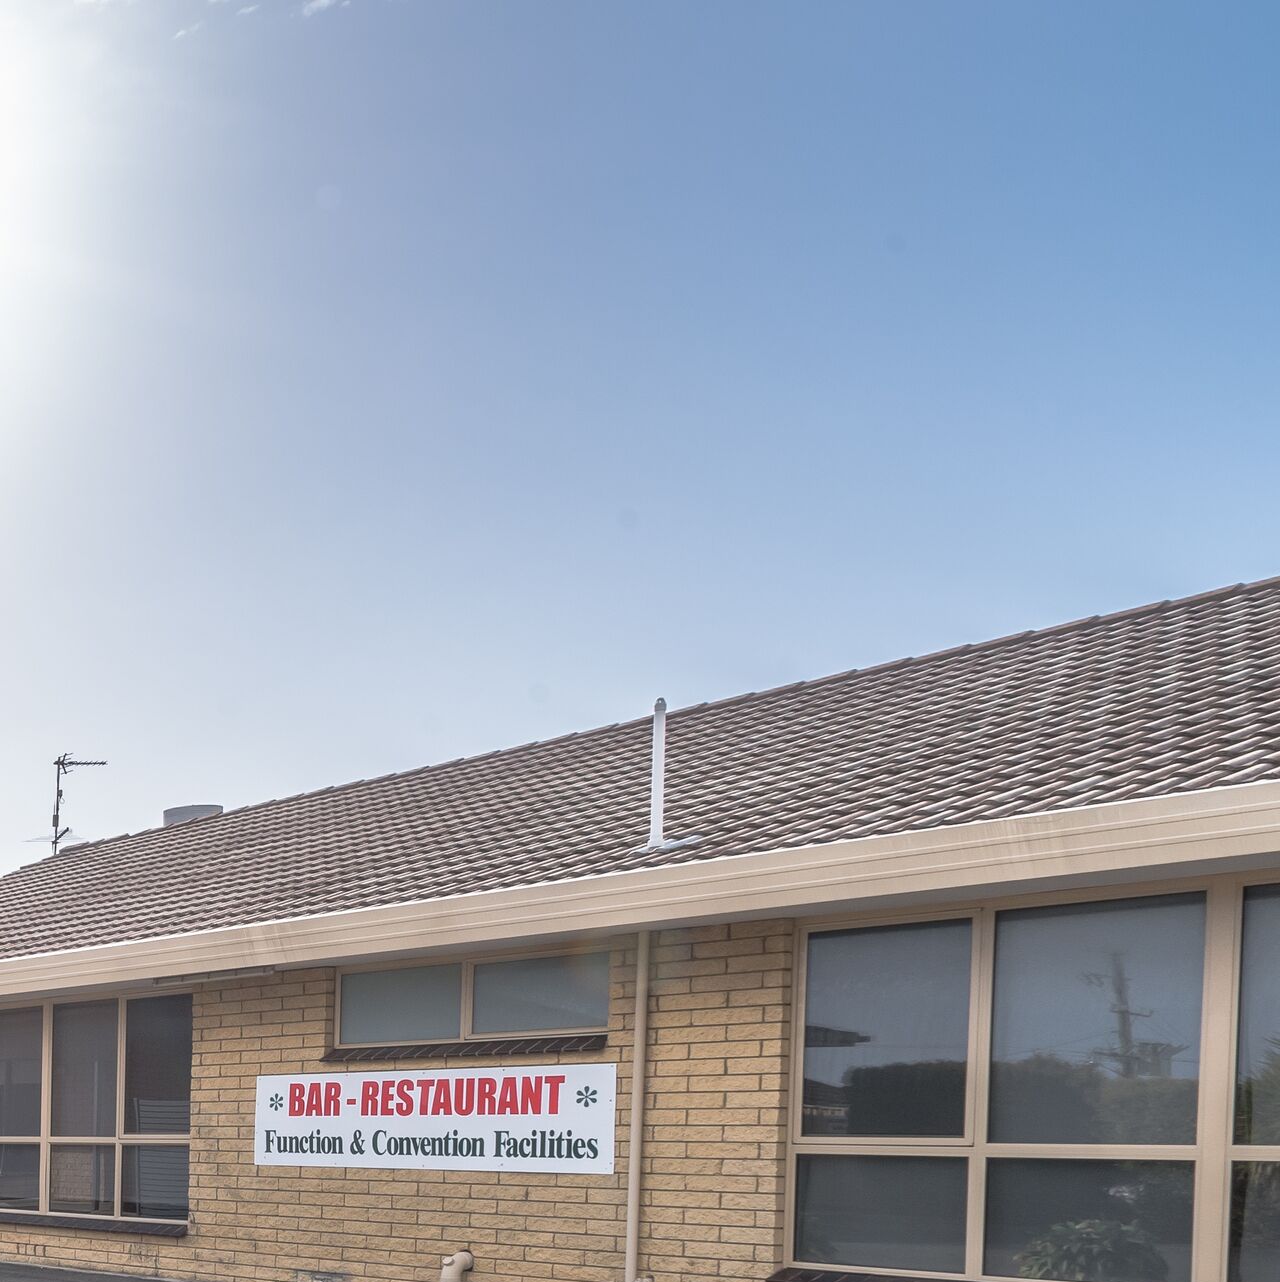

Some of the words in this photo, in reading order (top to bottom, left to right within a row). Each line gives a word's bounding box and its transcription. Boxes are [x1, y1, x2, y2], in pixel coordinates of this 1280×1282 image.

[264, 1129, 344, 1155] Function
[349, 1129, 366, 1155] &
[371, 1129, 486, 1158] Convention
[493, 1129, 599, 1160] Facilities
